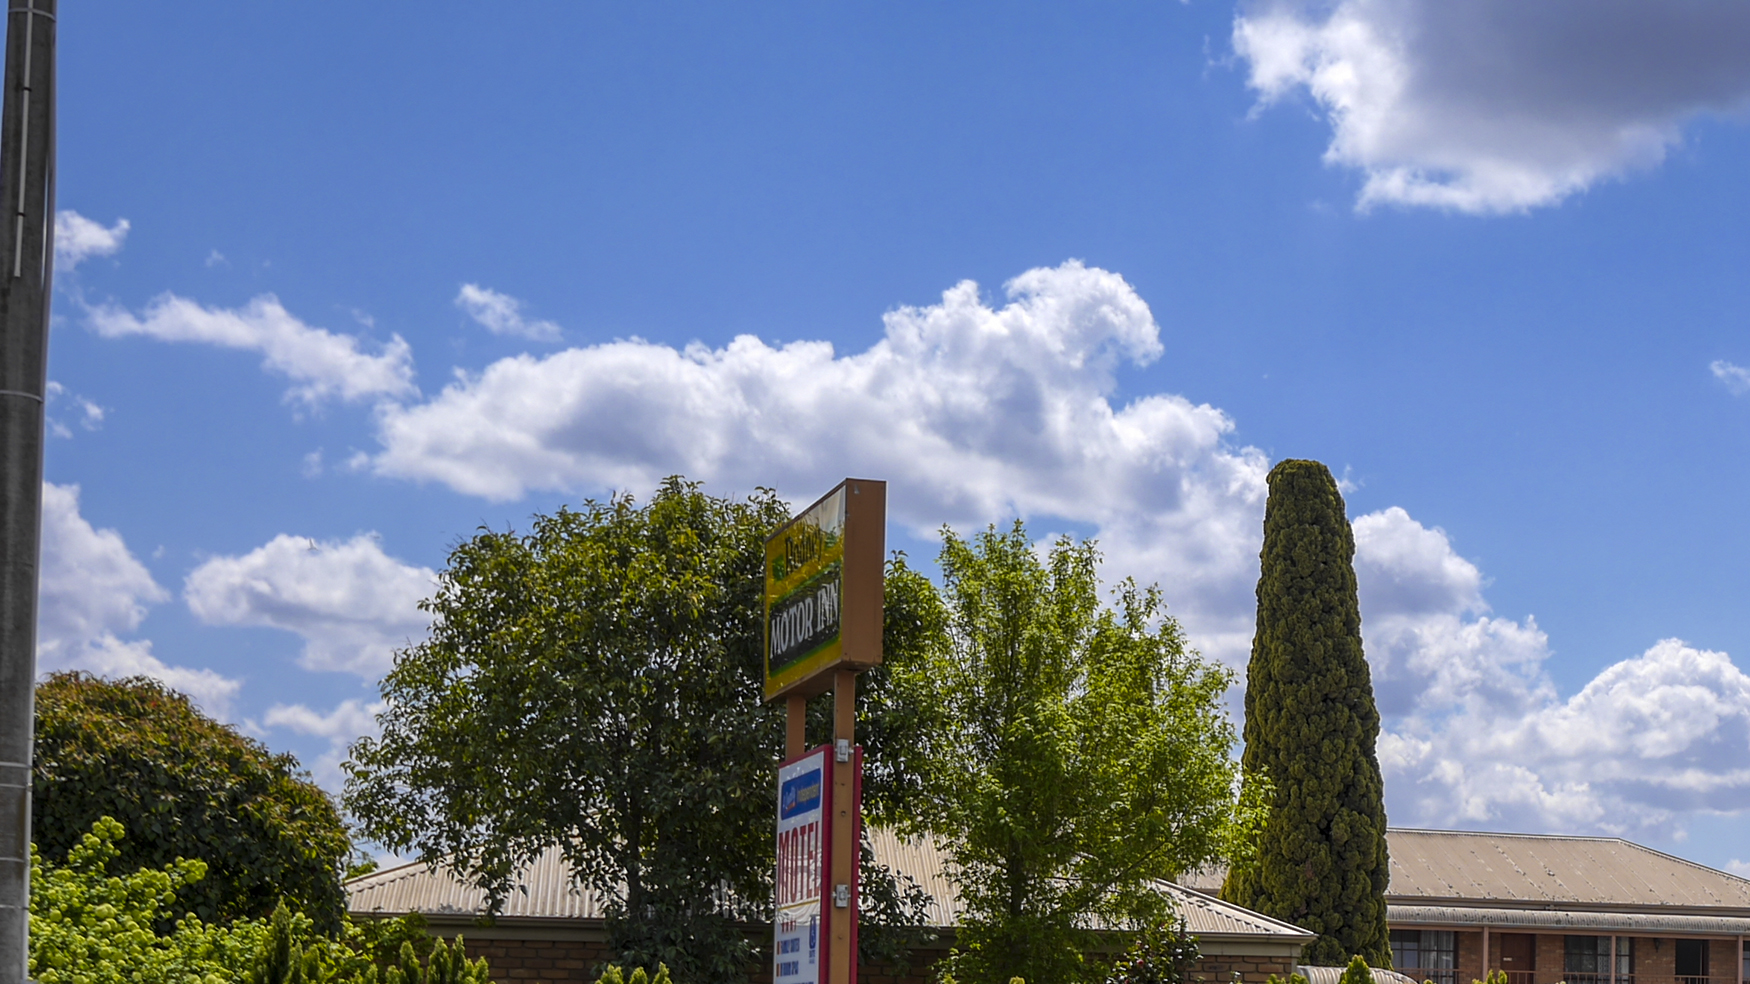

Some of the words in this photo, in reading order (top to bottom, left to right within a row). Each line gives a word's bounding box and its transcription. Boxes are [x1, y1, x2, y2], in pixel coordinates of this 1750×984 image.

[770, 598, 813, 659] MOTOR
[817, 579, 839, 632] INN
[777, 821, 821, 904] MOTEL
